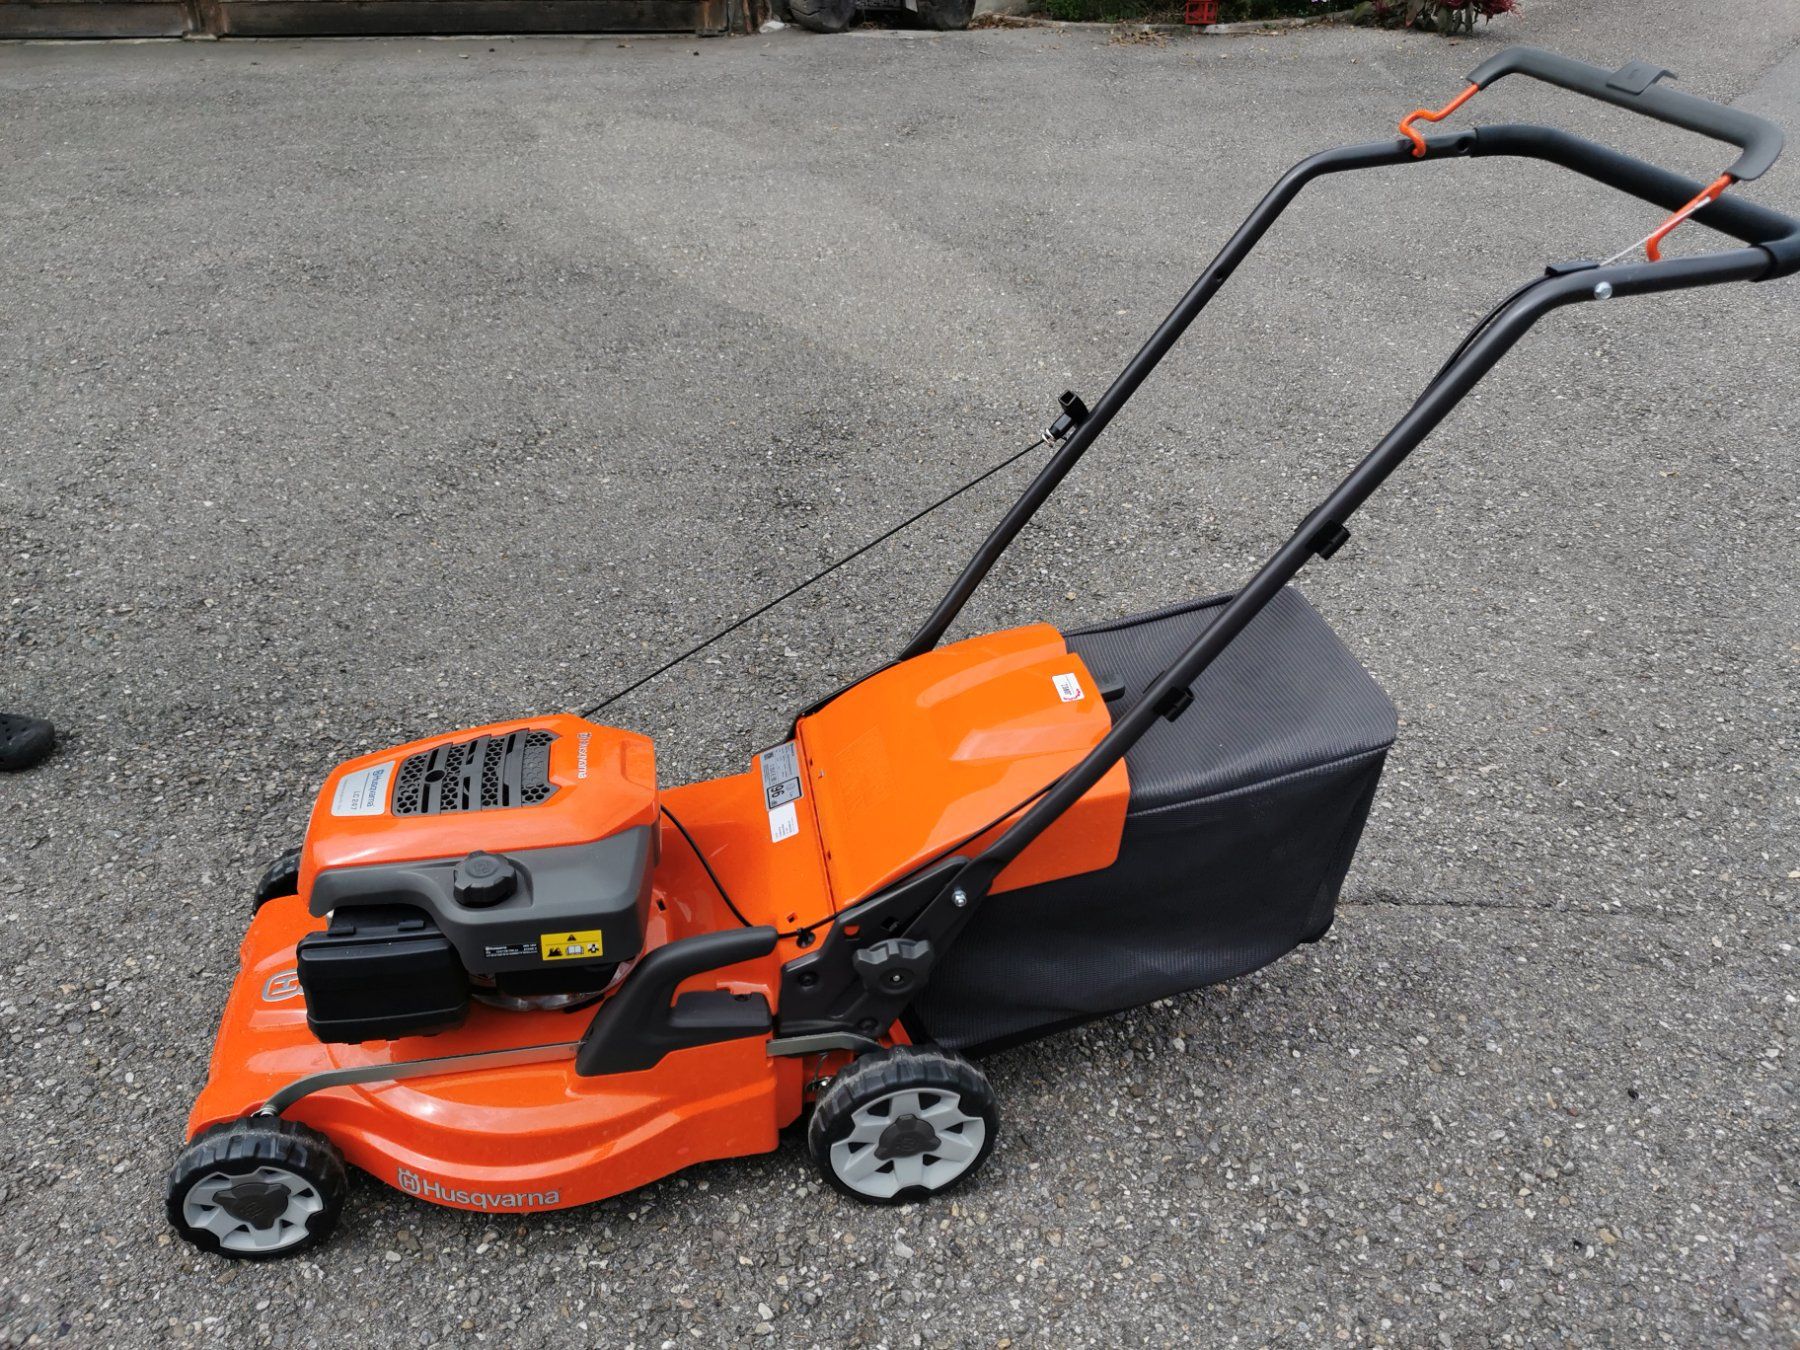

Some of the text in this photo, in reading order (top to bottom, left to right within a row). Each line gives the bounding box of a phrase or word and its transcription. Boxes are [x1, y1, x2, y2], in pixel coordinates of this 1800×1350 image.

[577, 739, 589, 779] Husqvarna
[366, 774, 380, 808] Husqvarna
[771, 783, 785, 799] 96
[422, 1179, 560, 1209] Husqvarna
